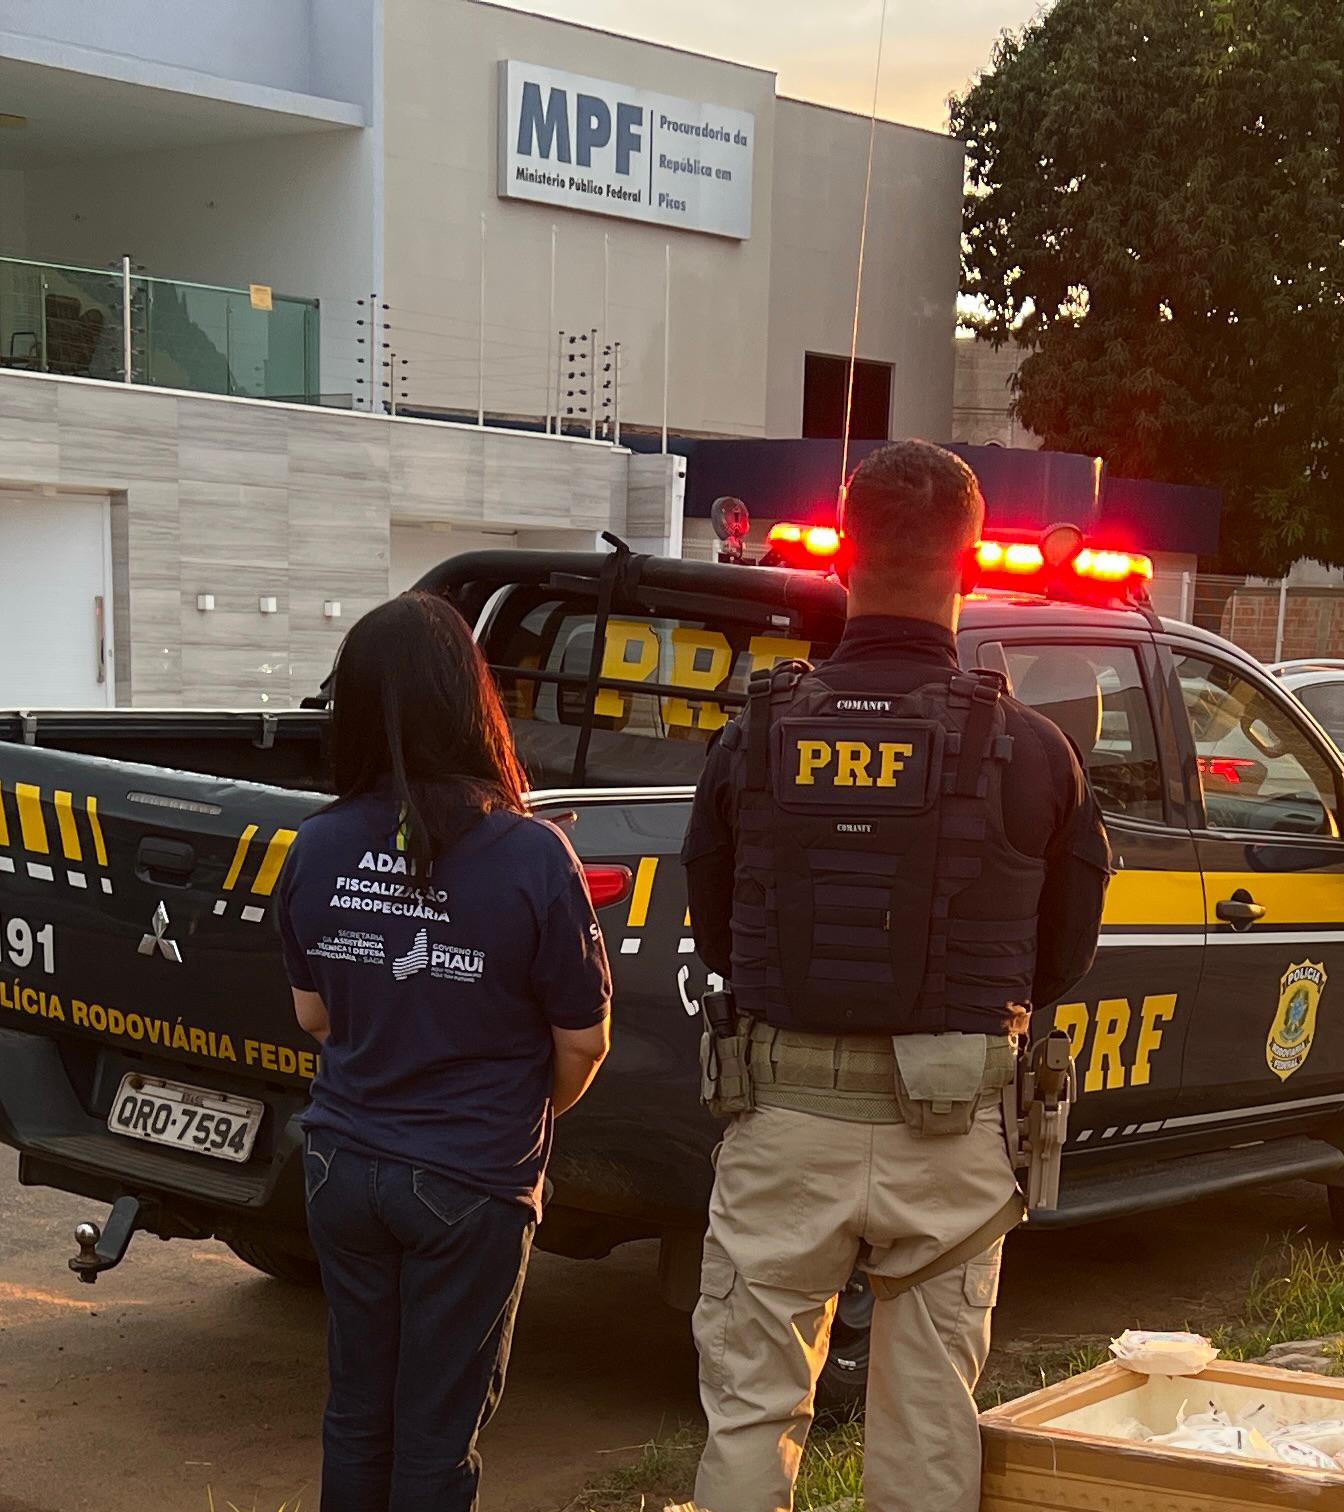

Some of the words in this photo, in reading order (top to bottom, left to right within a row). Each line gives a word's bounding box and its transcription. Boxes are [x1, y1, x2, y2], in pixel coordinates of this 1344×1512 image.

[517, 81, 643, 176] MPF
[660, 115, 730, 142] Procuradoria
[734, 130, 747, 146] da
[516, 166, 565, 189] Ministério
[569, 177, 603, 196] Público
[606, 185, 641, 203] Federal
[659, 154, 712, 177] República
[715, 168, 732, 181] em
[795, 740, 913, 787] PRF
[432, 943, 470, 955] GOVERNO
[473, 950, 485, 958] DO
[72, 1000, 236, 1062] RODOVIÁRIA
[245, 1039, 320, 1079] FEDE
